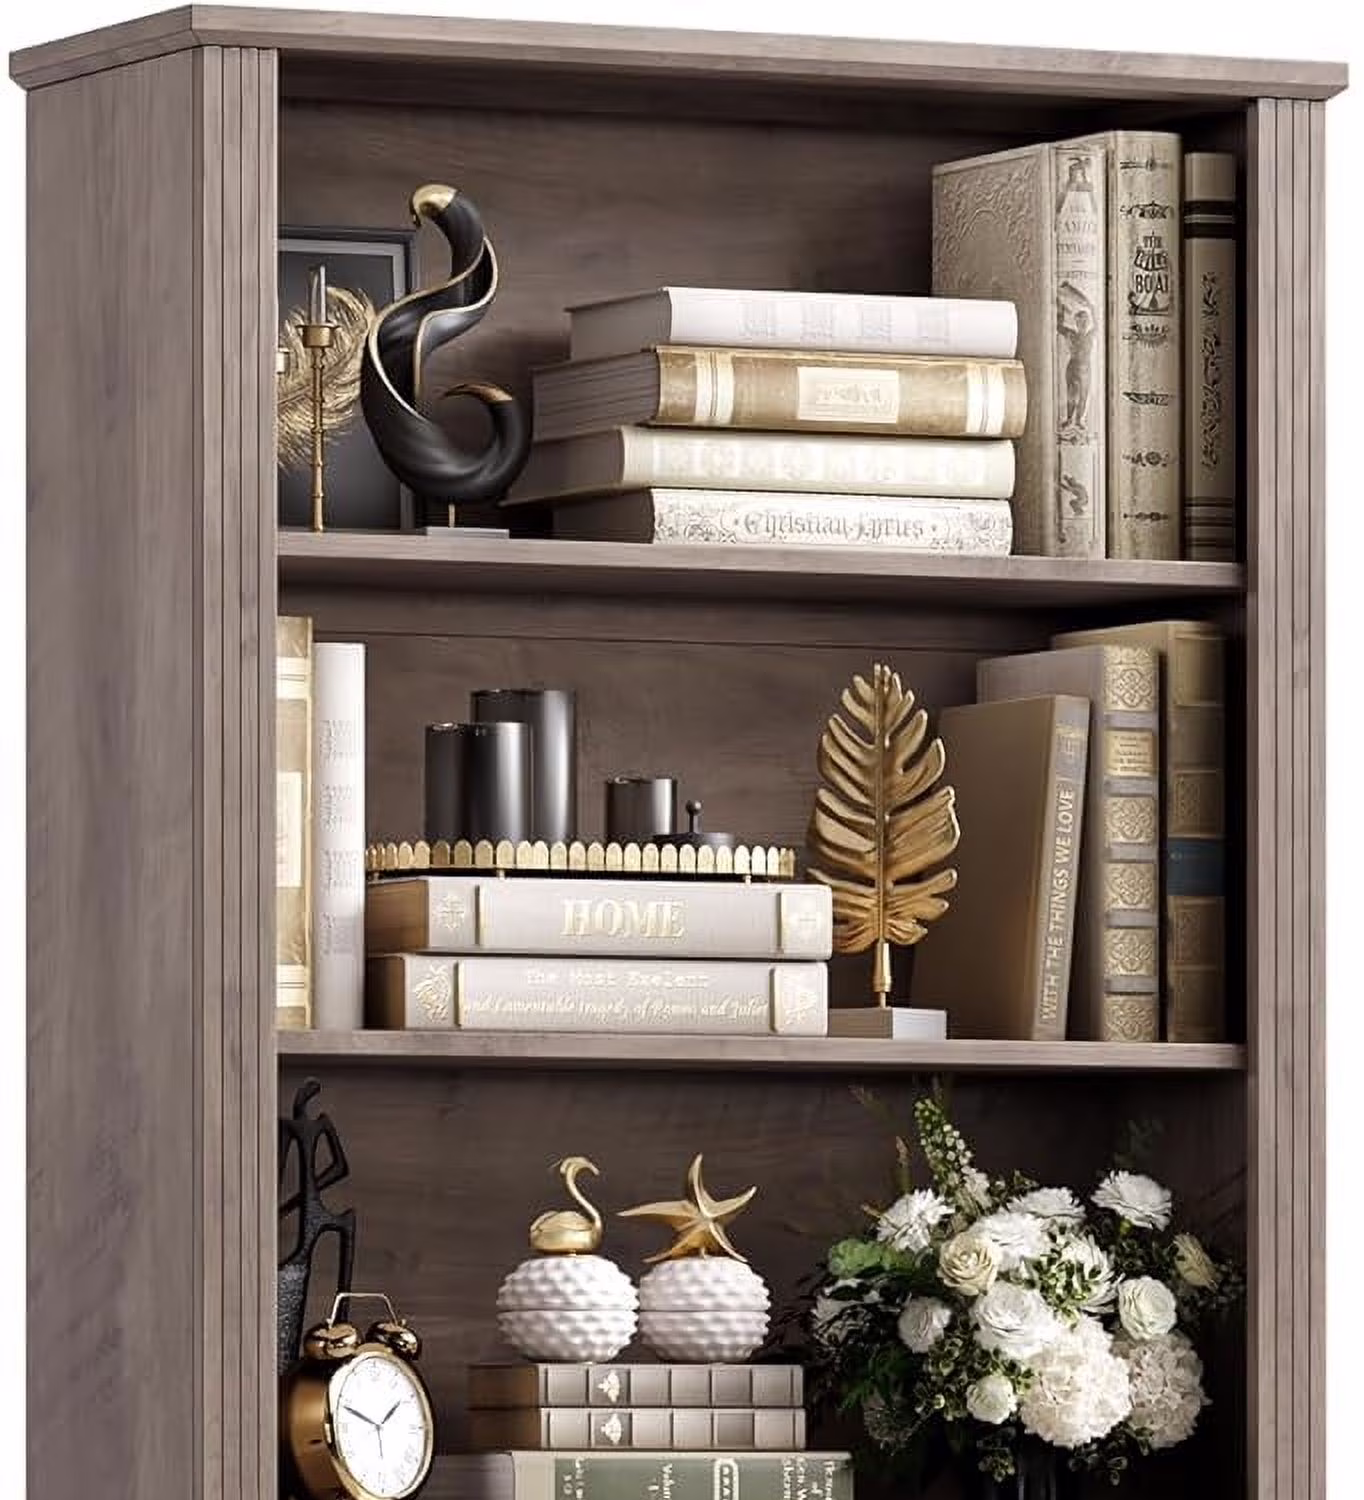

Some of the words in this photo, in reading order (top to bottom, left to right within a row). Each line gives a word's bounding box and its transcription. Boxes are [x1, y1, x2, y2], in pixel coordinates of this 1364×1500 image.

[1057, 788, 1075, 833] LOVE
[1055, 836, 1072, 865] WE
[560, 898, 685, 939] HOME
[1050, 868, 1069, 935] THINGS
[1047, 936, 1064, 968] THE
[1039, 975, 1060, 1023] WITH
